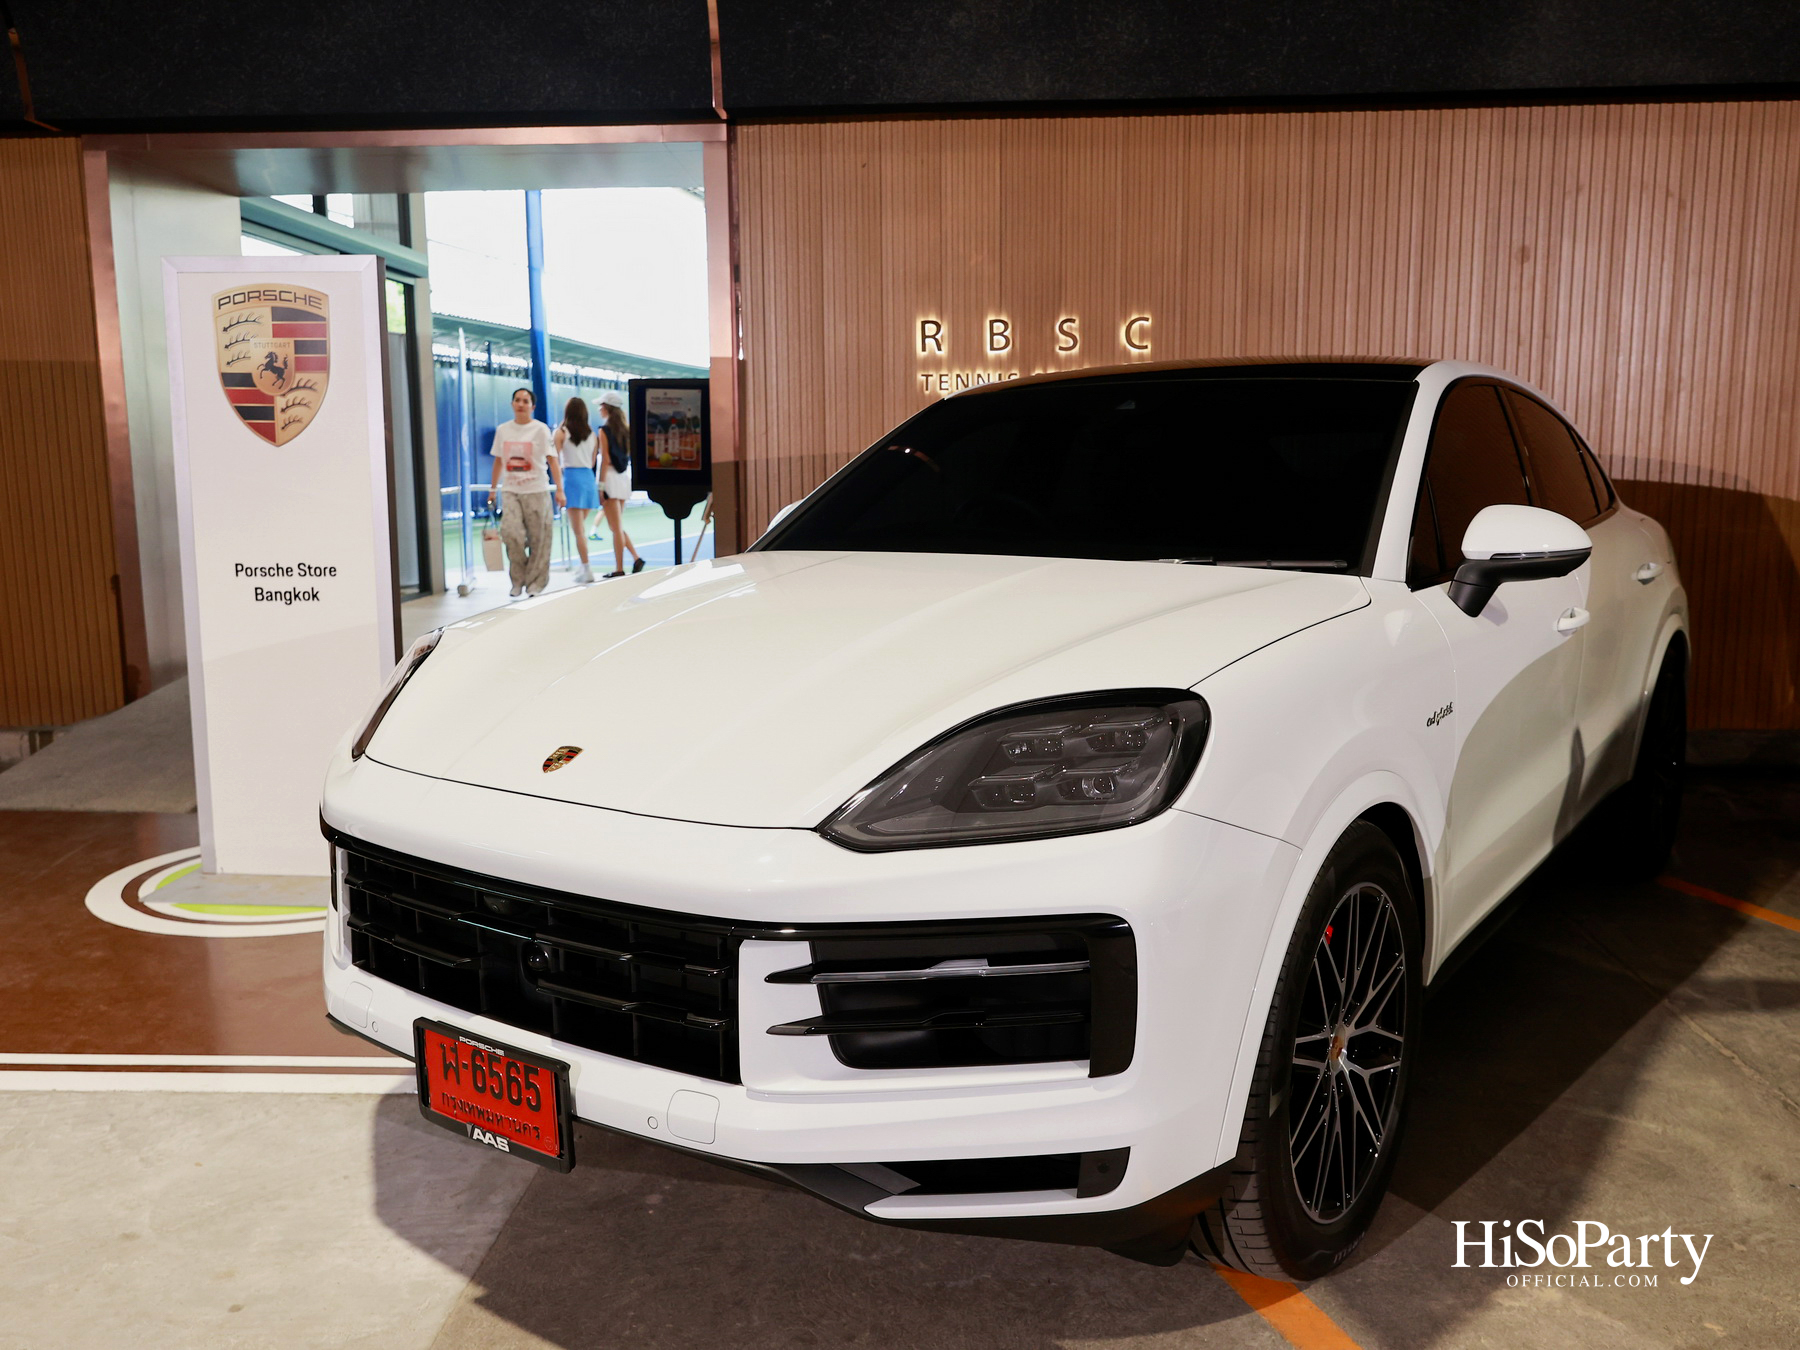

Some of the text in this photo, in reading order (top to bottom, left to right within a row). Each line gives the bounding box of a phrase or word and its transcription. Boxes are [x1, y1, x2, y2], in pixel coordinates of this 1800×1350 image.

[218, 290, 322, 310] PORSCHE
[235, 562, 337, 577] Porsche Store
[254, 587, 320, 605] Bangkok
[459, 1036, 505, 1057] PORSCHE
[442, 1092, 541, 1141] กรุงเทพมหานคร
[473, 1128, 510, 1153] AAS
